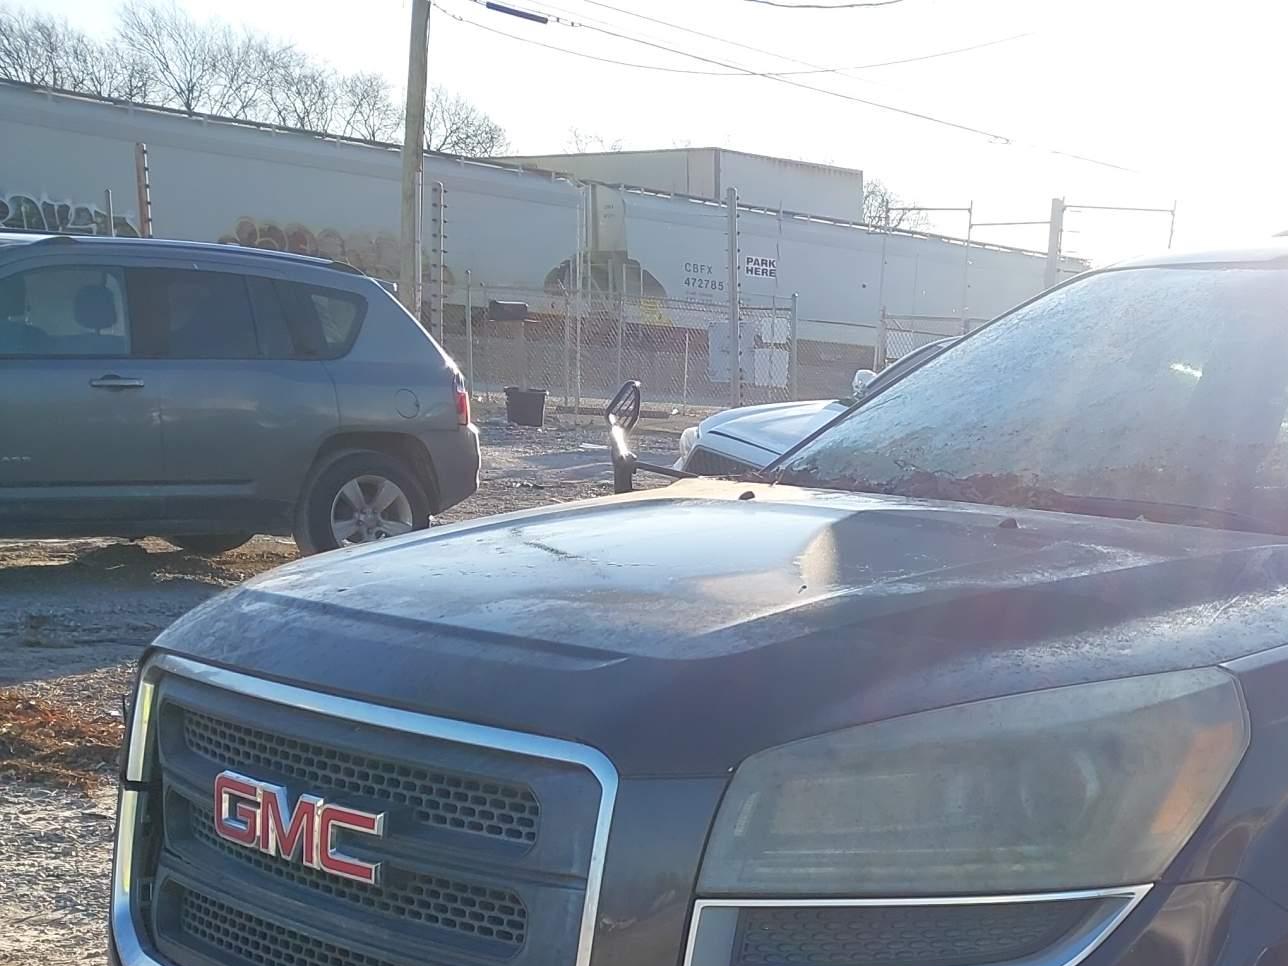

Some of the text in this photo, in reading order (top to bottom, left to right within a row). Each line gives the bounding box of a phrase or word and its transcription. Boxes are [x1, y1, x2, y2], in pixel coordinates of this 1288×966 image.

[684, 262, 713, 275] CBFX
[746, 257, 777, 269] PARK
[745, 267, 777, 278] HERE
[684, 277, 725, 291] 472785
[214, 770, 387, 885] GMC
